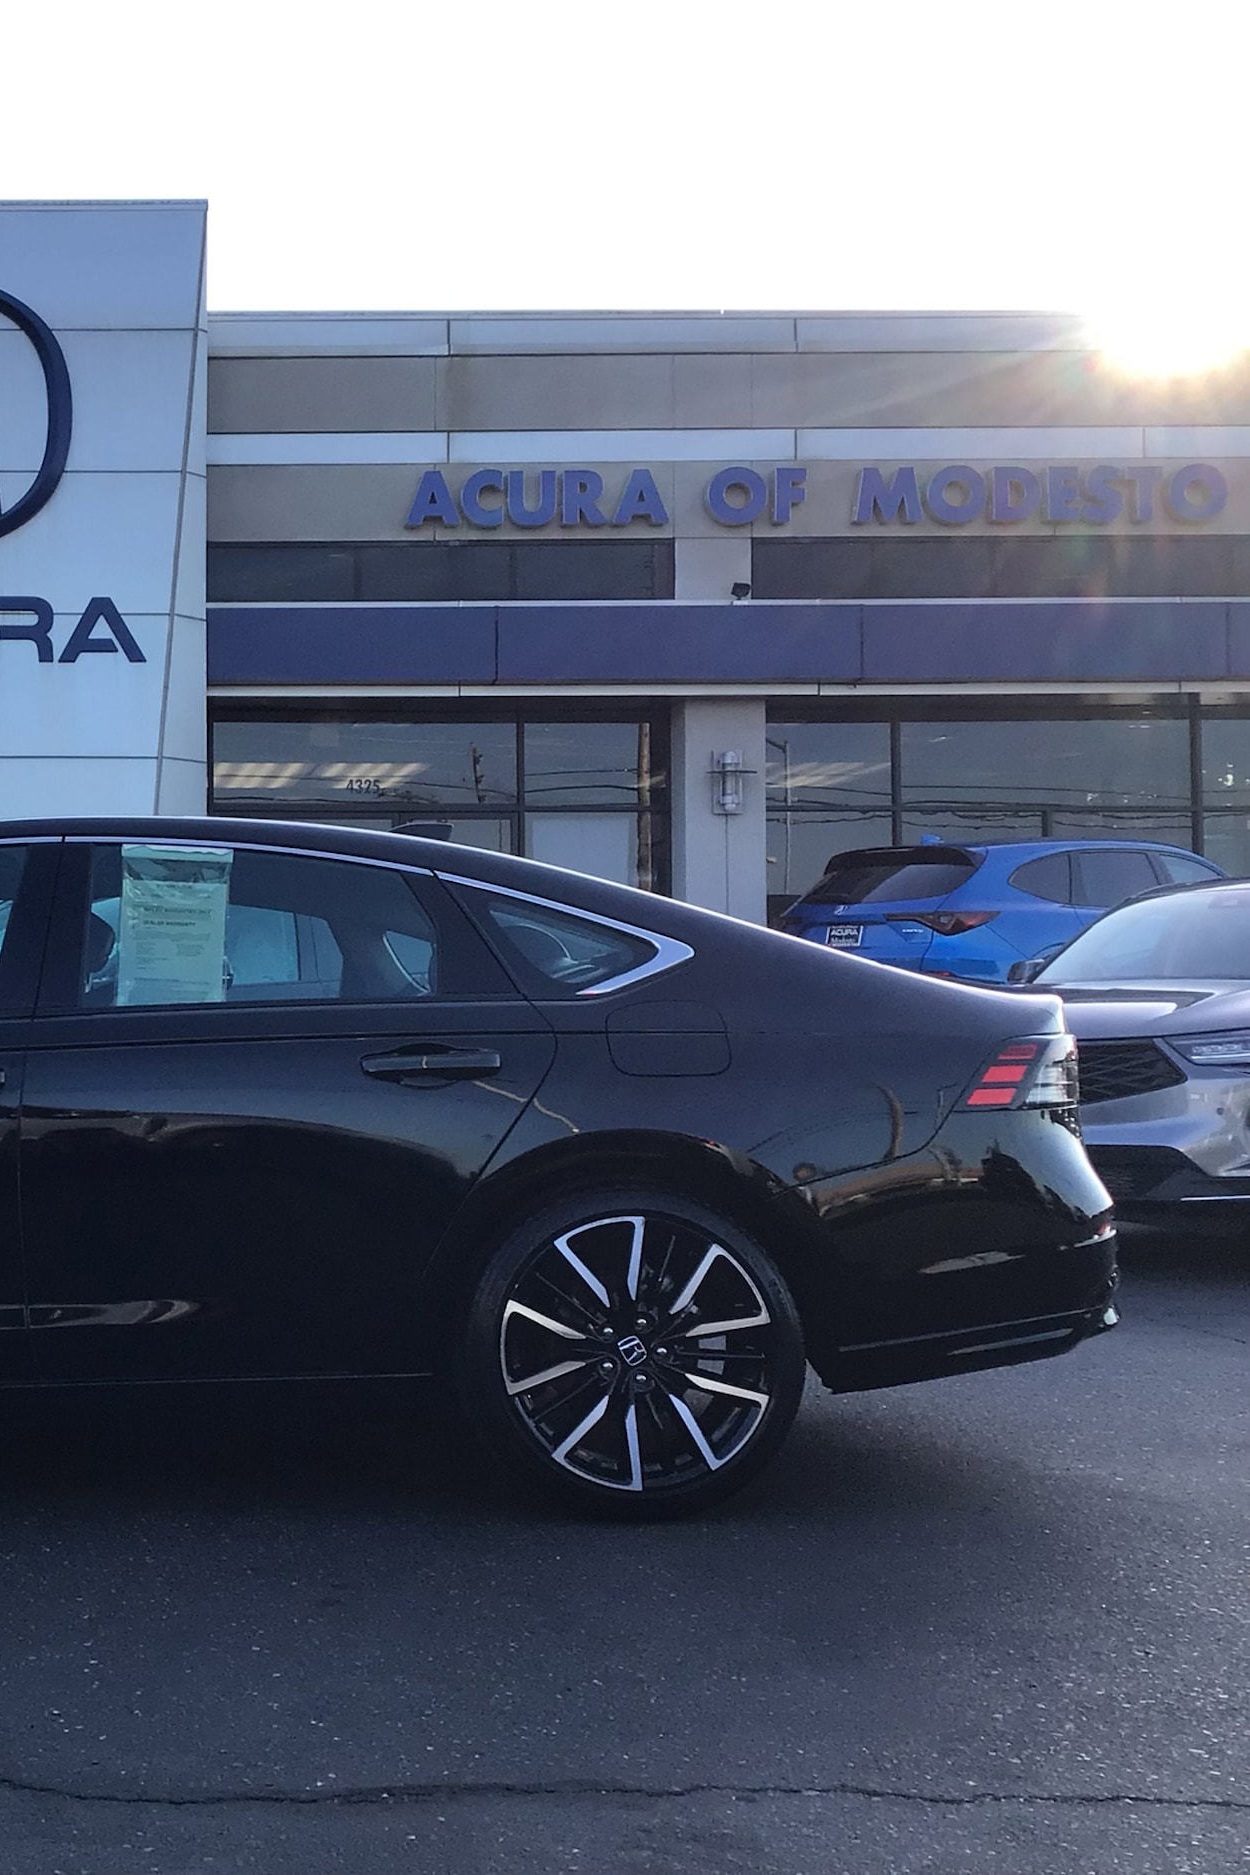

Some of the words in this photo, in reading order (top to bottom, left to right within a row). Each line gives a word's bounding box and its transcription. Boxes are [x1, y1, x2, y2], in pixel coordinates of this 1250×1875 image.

[405, 467, 670, 530] ACURA
[706, 465, 808, 528] OF
[851, 462, 1229, 528] MODESTO
[345, 779, 381, 794] 4325
[830, 928, 858, 936] ACURA
